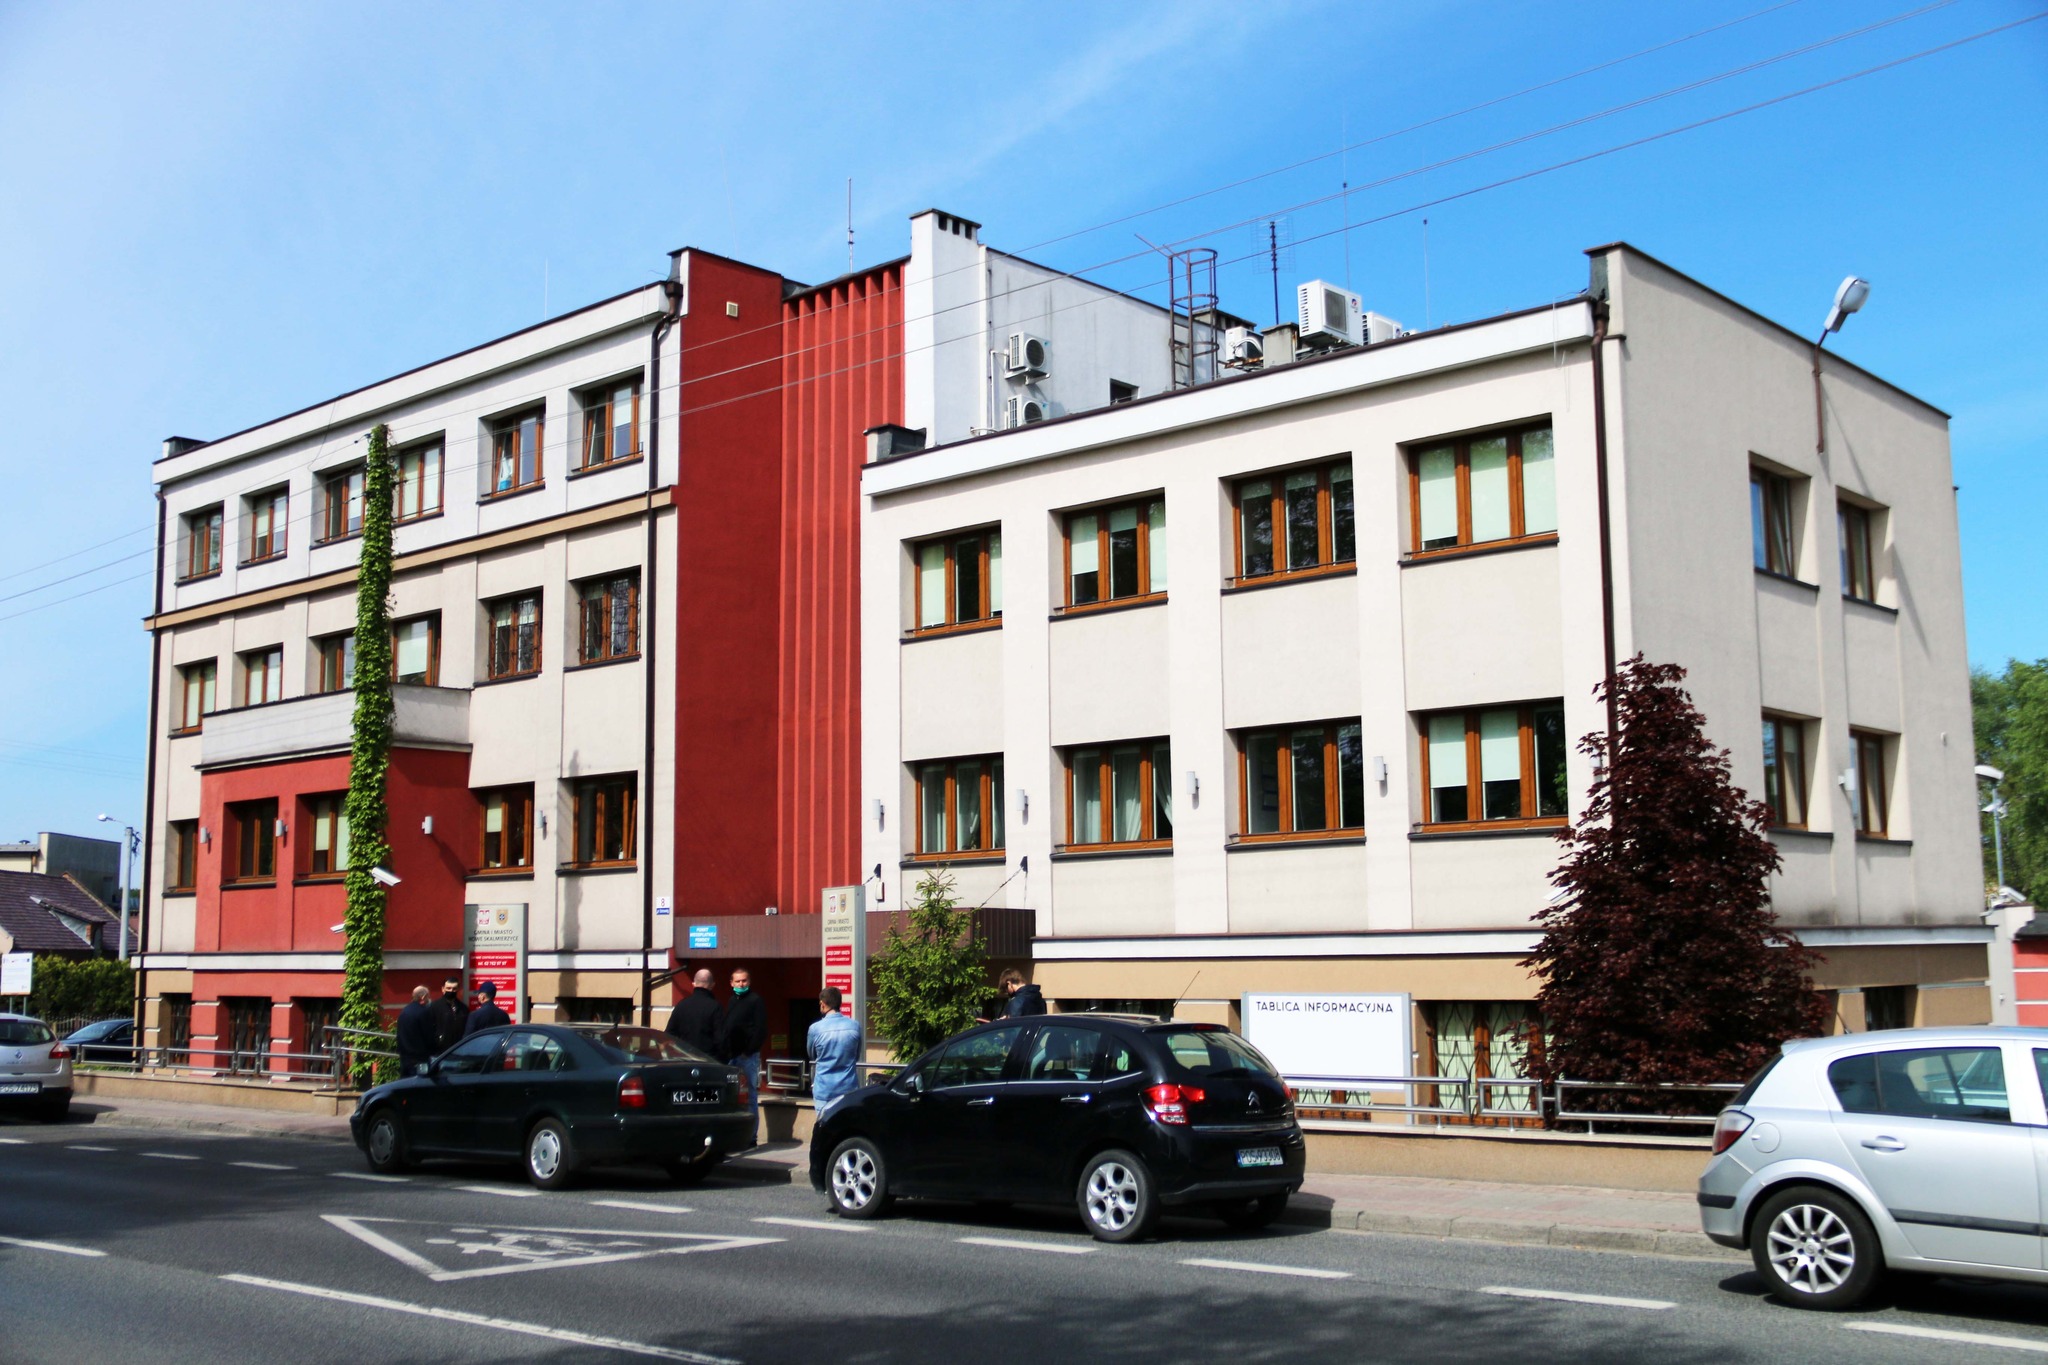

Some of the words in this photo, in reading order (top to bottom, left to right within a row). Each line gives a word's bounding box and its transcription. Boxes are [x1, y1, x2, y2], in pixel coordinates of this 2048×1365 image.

[660, 897, 666, 907] 8
[1256, 1001, 1300, 1012] TABLICA
[1304, 1001, 1394, 1013] INFORMACYJNA
[672, 1091, 693, 1102] KPO
